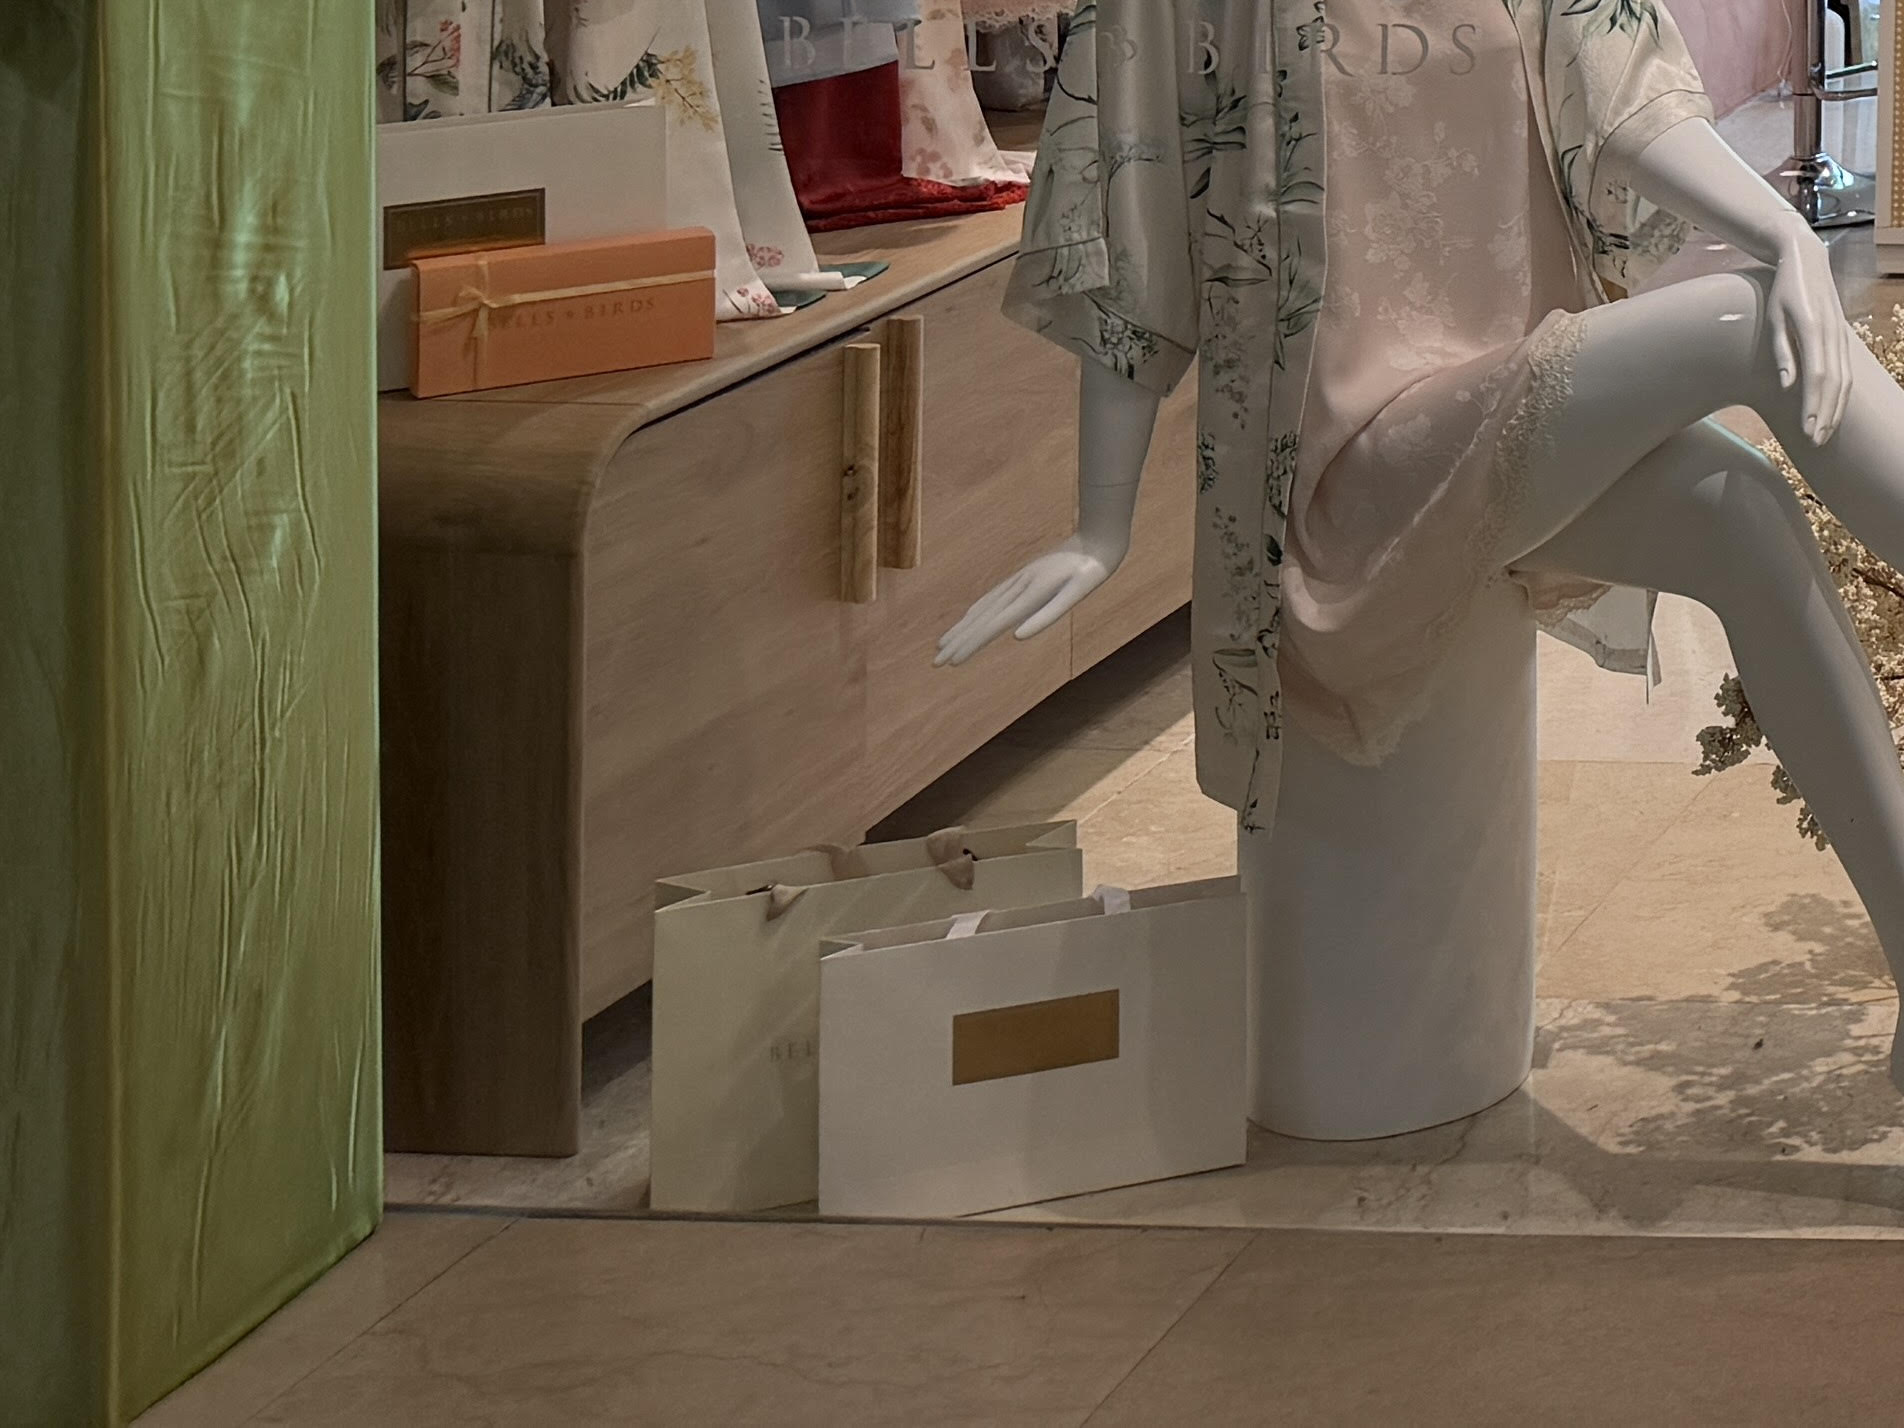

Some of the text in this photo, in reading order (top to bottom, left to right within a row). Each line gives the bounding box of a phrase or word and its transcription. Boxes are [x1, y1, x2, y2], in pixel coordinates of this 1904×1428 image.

[778, 15, 1478, 77] BELLS BIRDS
[575, 297, 656, 320] BIRDS
